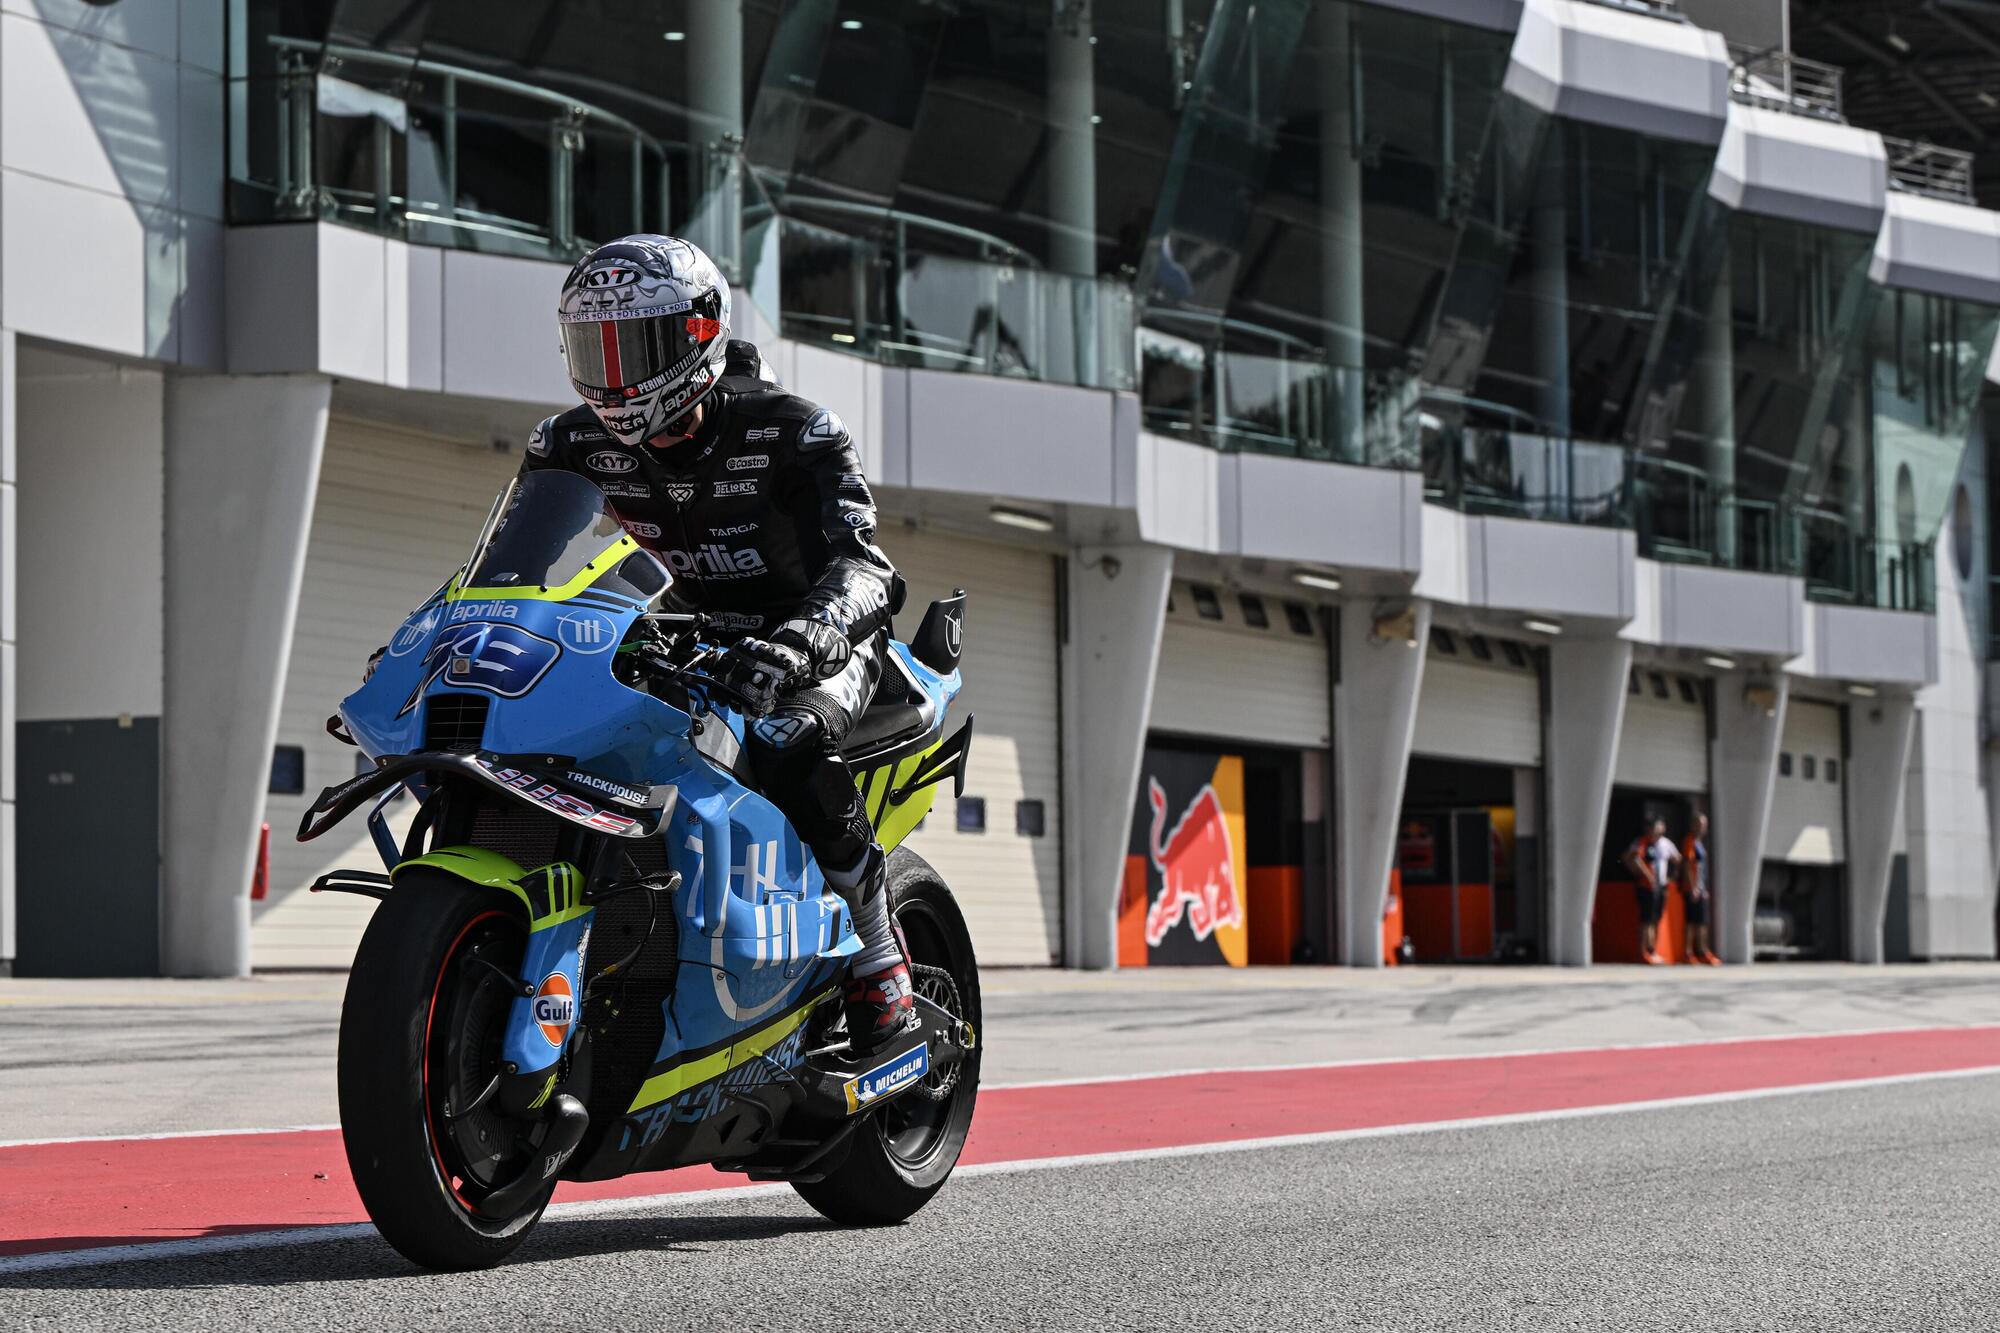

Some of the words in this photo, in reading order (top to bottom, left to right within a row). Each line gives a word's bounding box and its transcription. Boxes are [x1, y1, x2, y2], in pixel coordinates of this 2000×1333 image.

[577, 269, 641, 289] KYT
[623, 310, 640, 318] DTS
[650, 306, 666, 315] DTS
[674, 302, 689, 310] DTS
[637, 372, 666, 394] PERINI
[664, 366, 709, 412] aprilia
[589, 453, 635, 471] KYT
[709, 522, 759, 537] TARGA
[451, 600, 519, 620] aprilia
[567, 771, 649, 804] TRACKHOUSE
[536, 1000, 573, 1021] Gulf
[875, 1056, 923, 1092] MICHELIN
